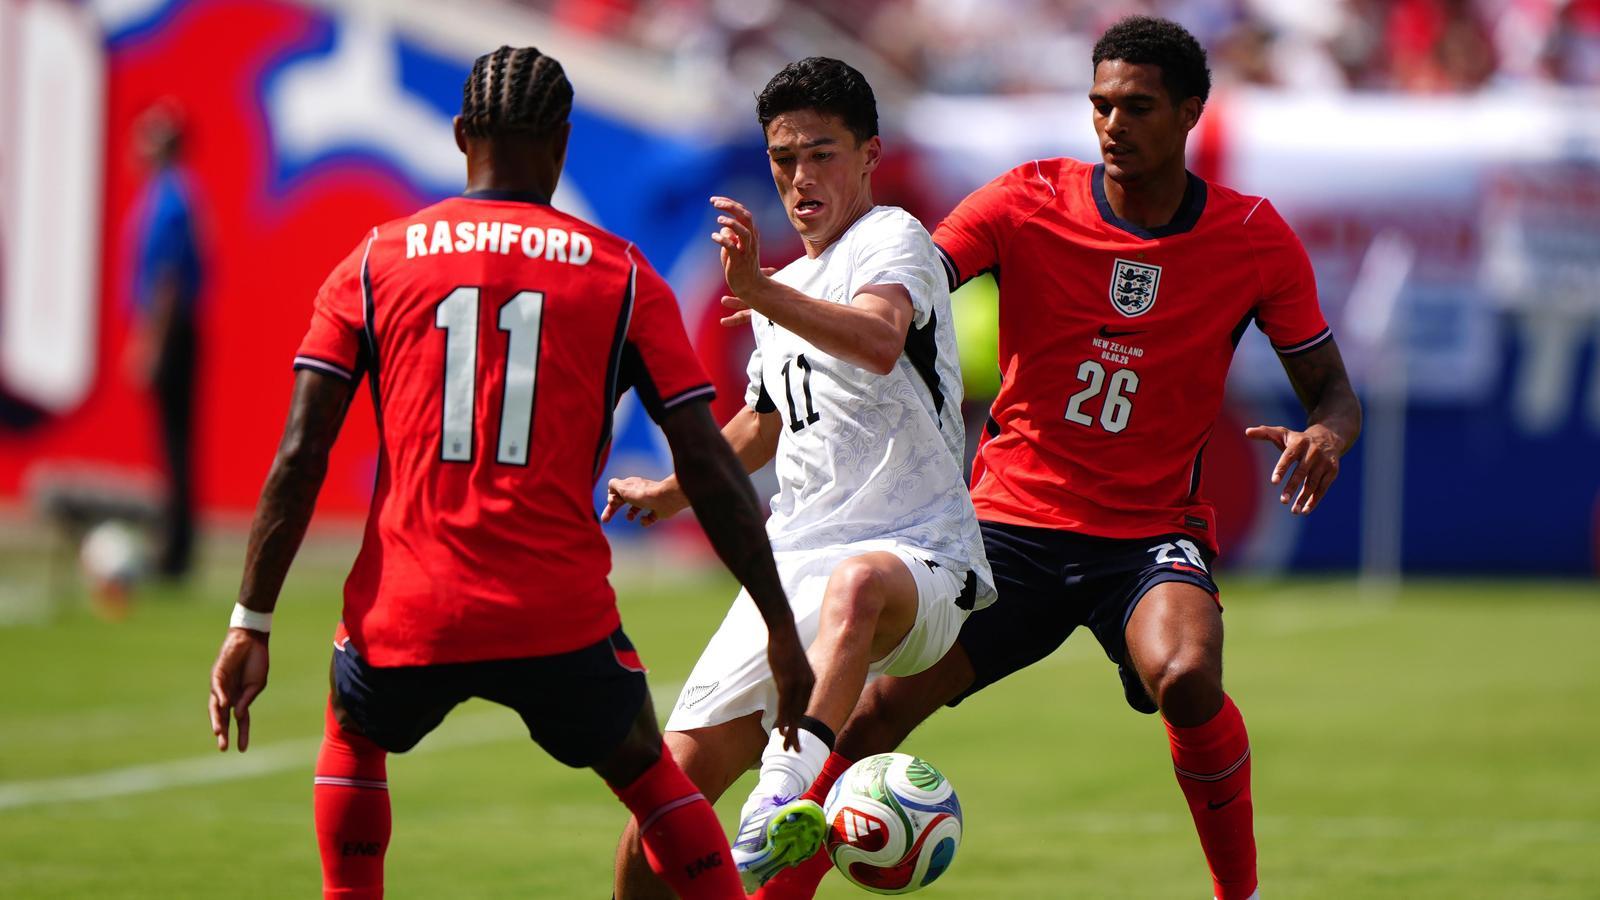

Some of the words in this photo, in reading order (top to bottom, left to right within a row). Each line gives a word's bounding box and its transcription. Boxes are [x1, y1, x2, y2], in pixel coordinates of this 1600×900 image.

[406, 220, 593, 266] RASHFORD
[435, 286, 544, 466] 11
[1092, 337, 1109, 349] NEW
[1109, 342, 1144, 358] ZEALAND
[781, 353, 820, 433] 11
[1064, 359, 1140, 434] 26
